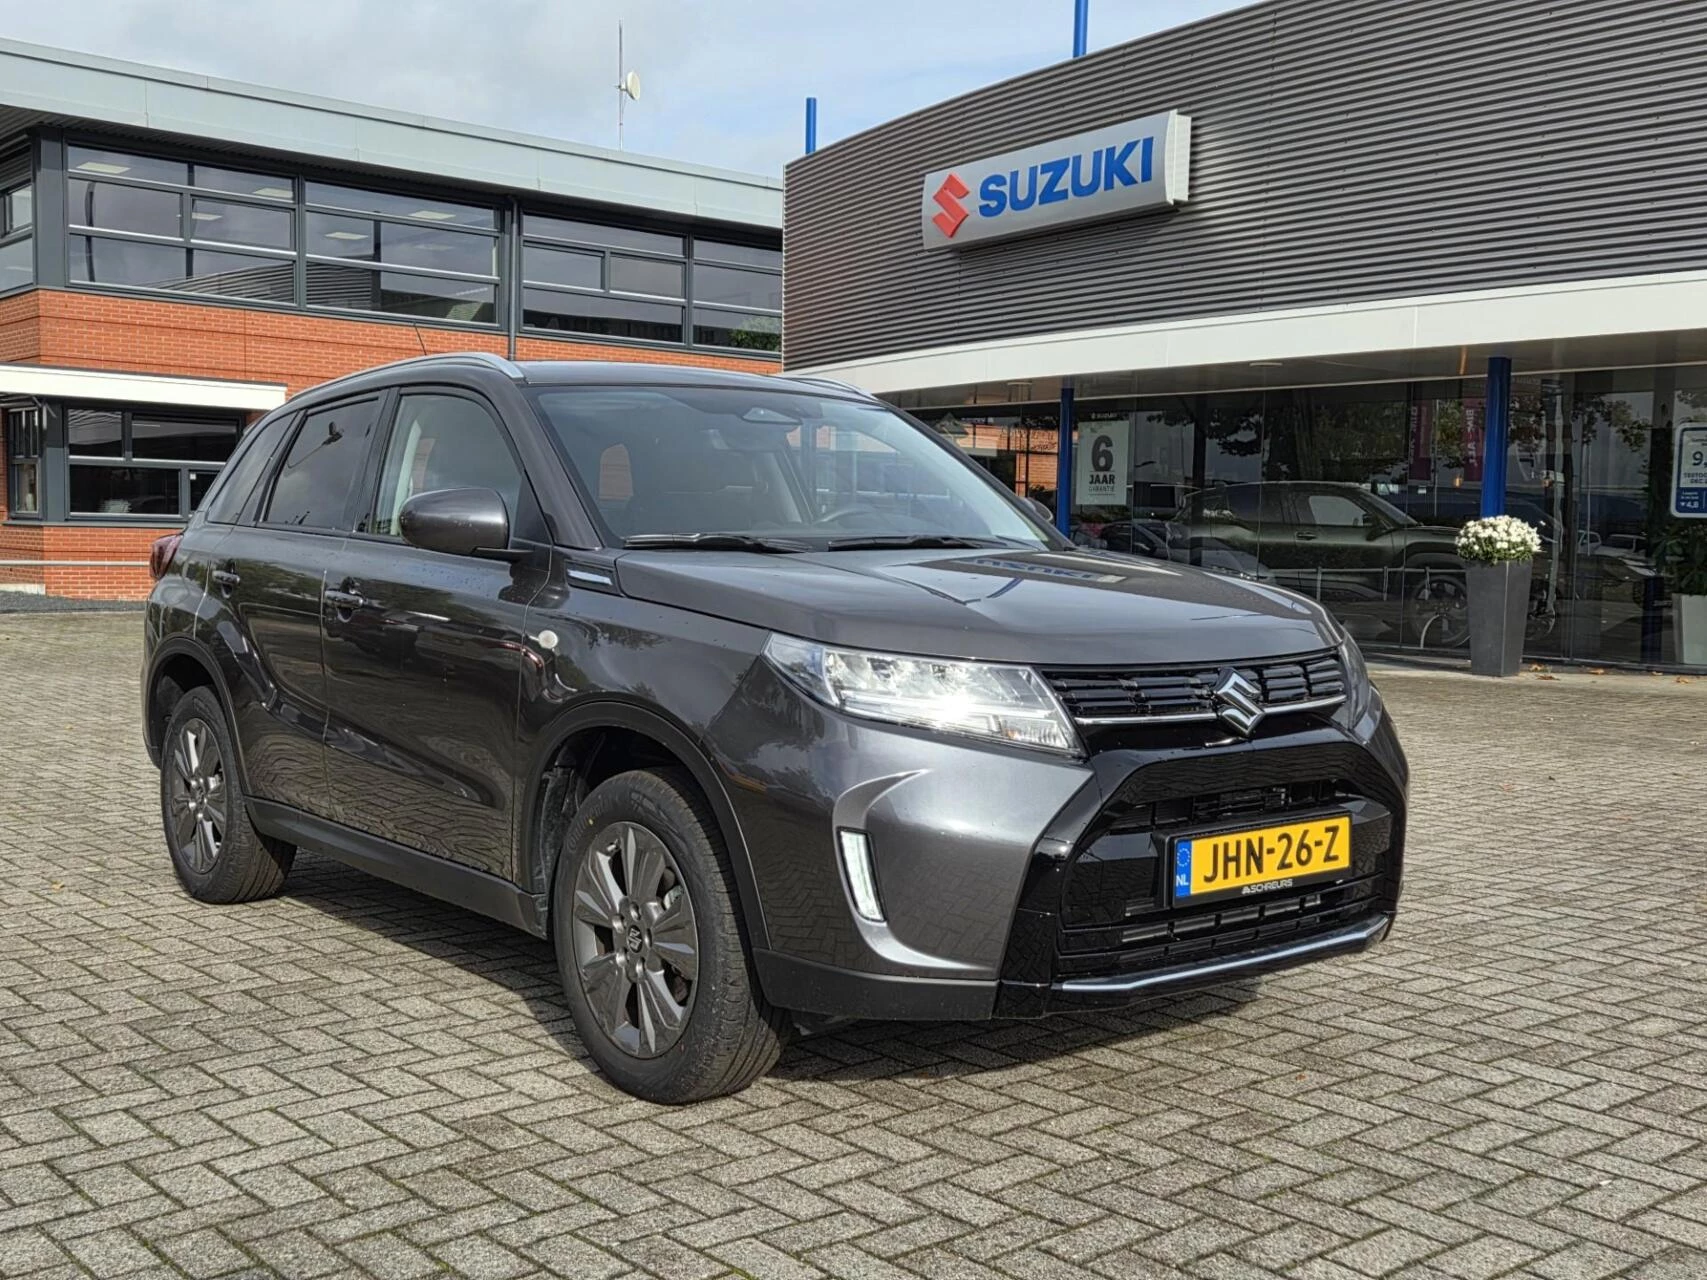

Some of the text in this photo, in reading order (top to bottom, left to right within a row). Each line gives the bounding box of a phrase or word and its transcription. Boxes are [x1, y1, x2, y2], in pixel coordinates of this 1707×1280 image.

[978, 136, 1154, 218] SUZUKI
[1091, 434, 1114, 471] 6
[1089, 474, 1116, 485] JAAR
[1203, 825, 1340, 883] JHN-26-Z
[1176, 874, 1189, 887] NL
[1250, 878, 1293, 894] SCHREURS
